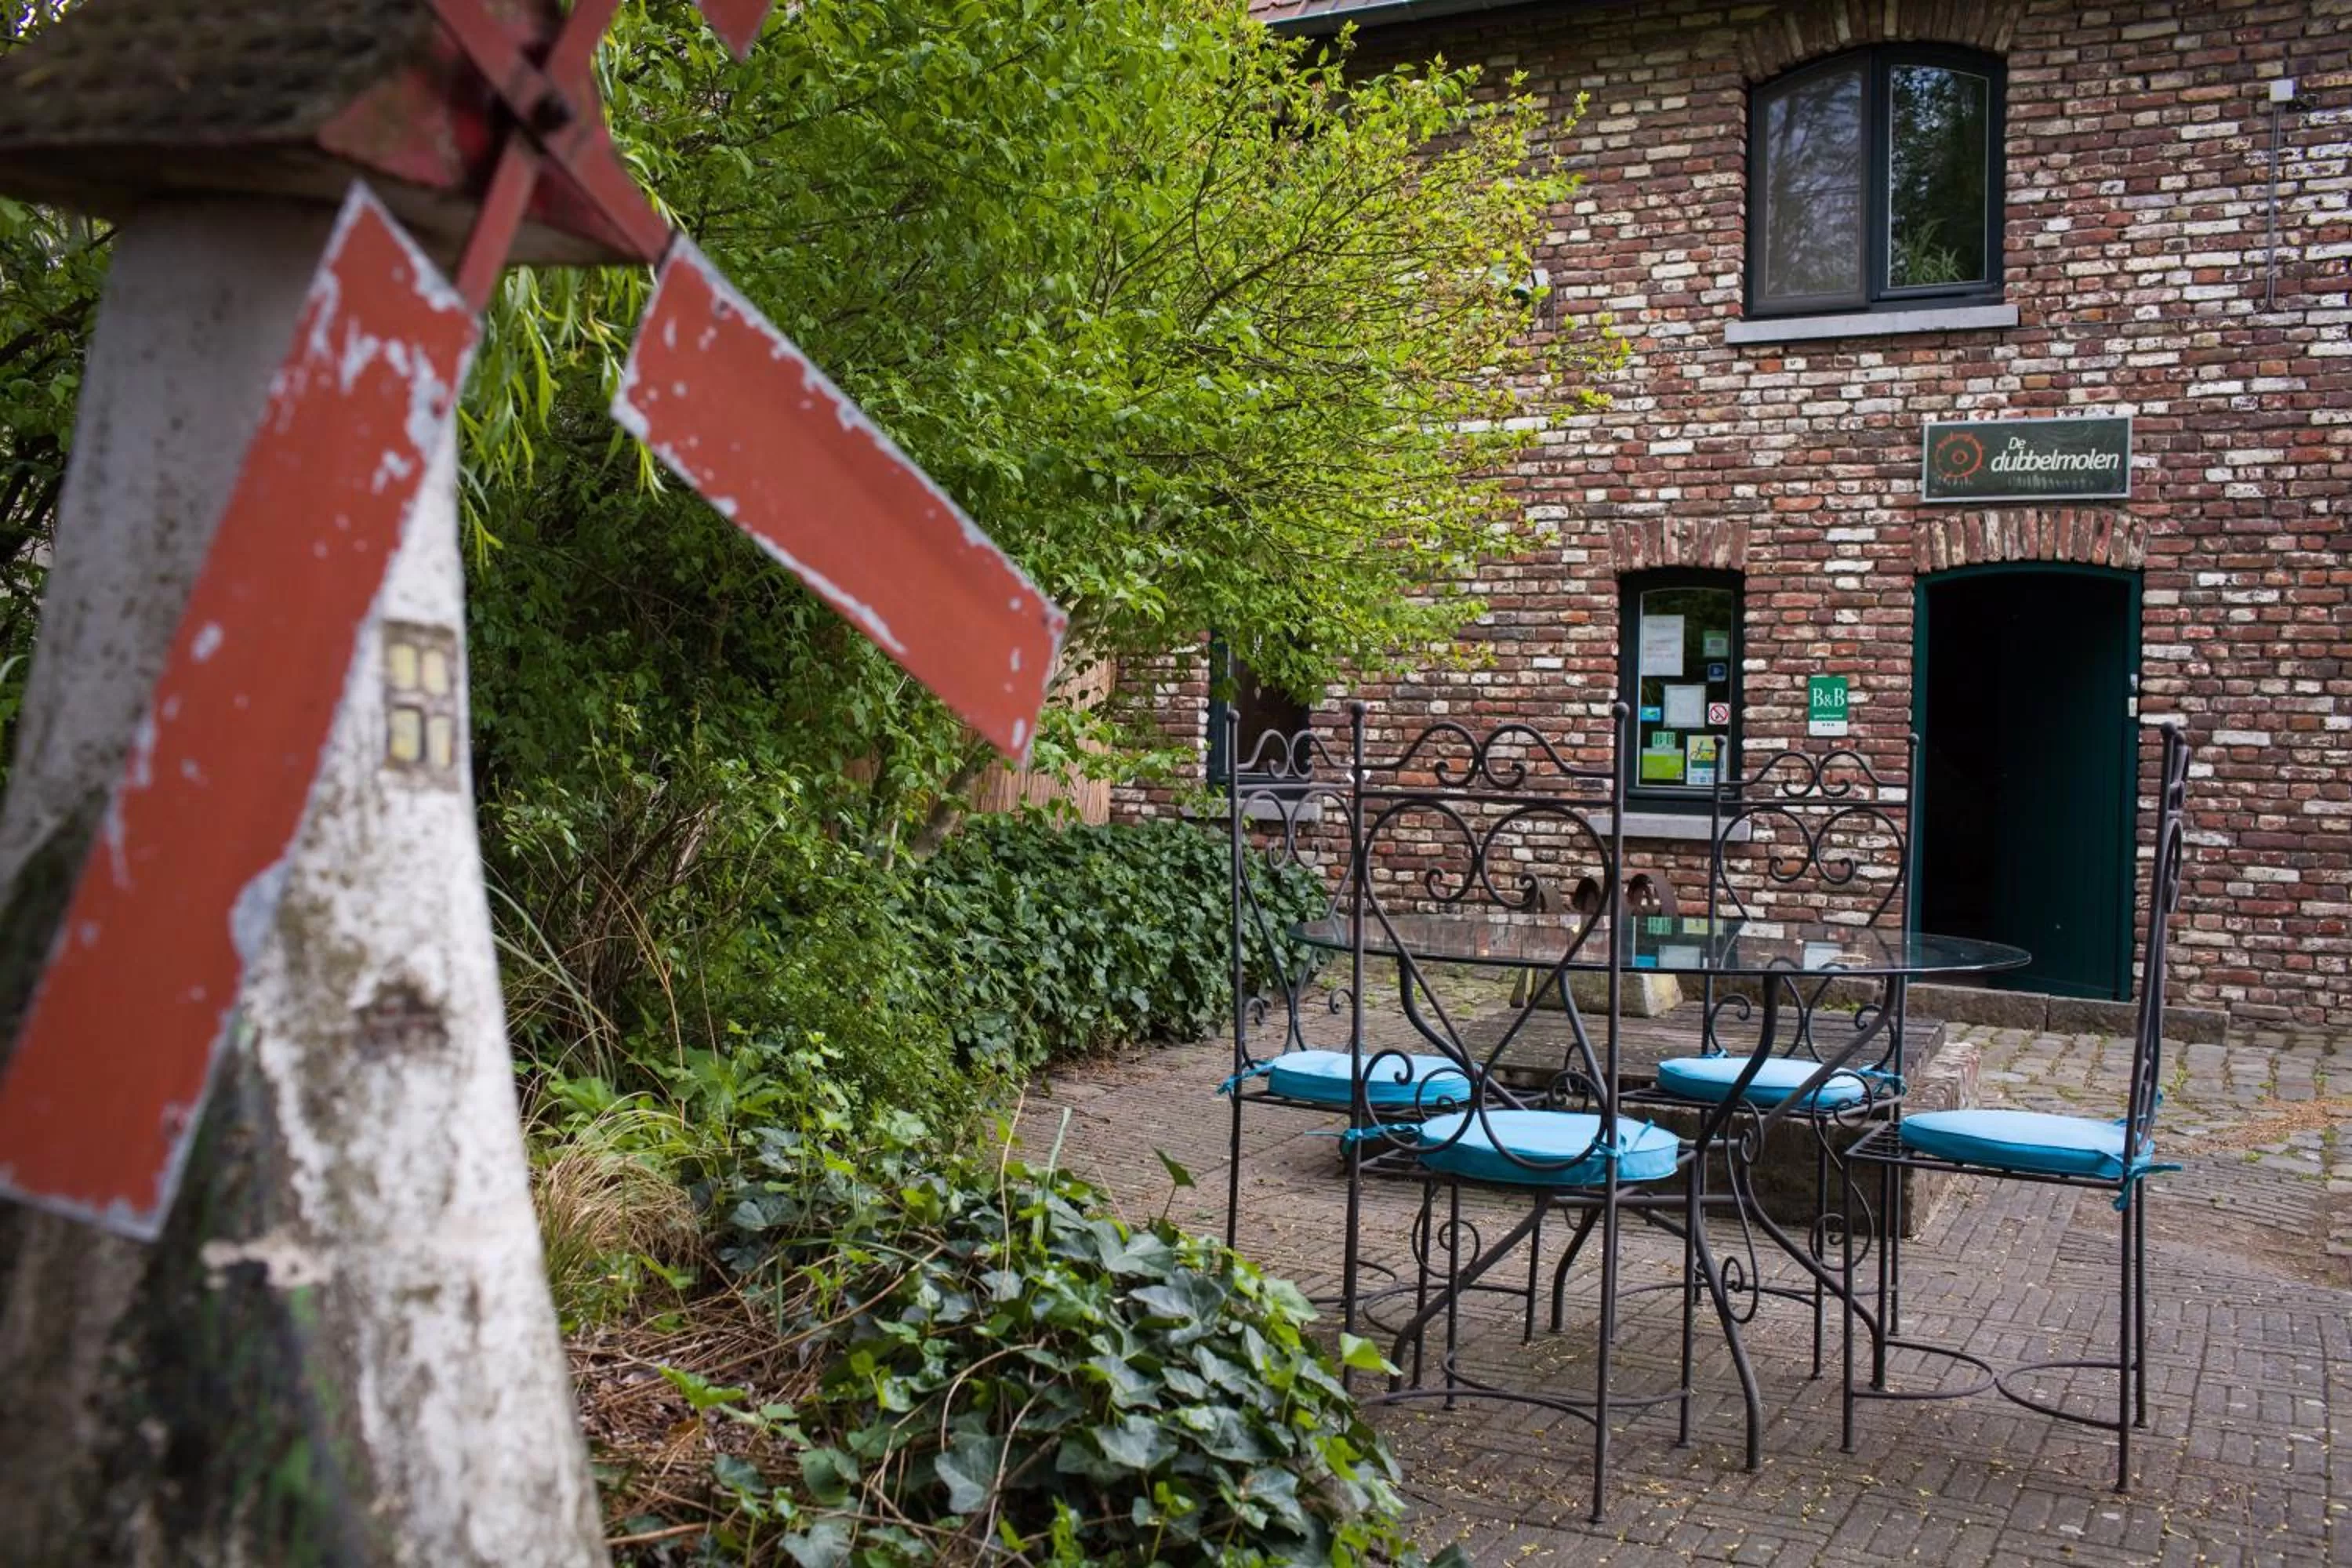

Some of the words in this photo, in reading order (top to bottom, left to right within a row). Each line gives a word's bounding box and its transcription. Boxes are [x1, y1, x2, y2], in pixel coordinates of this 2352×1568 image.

[2009, 437, 2026, 449] De
[1991, 449, 2119, 472] dubbelmolen
[1813, 688, 1845, 707] B&B
